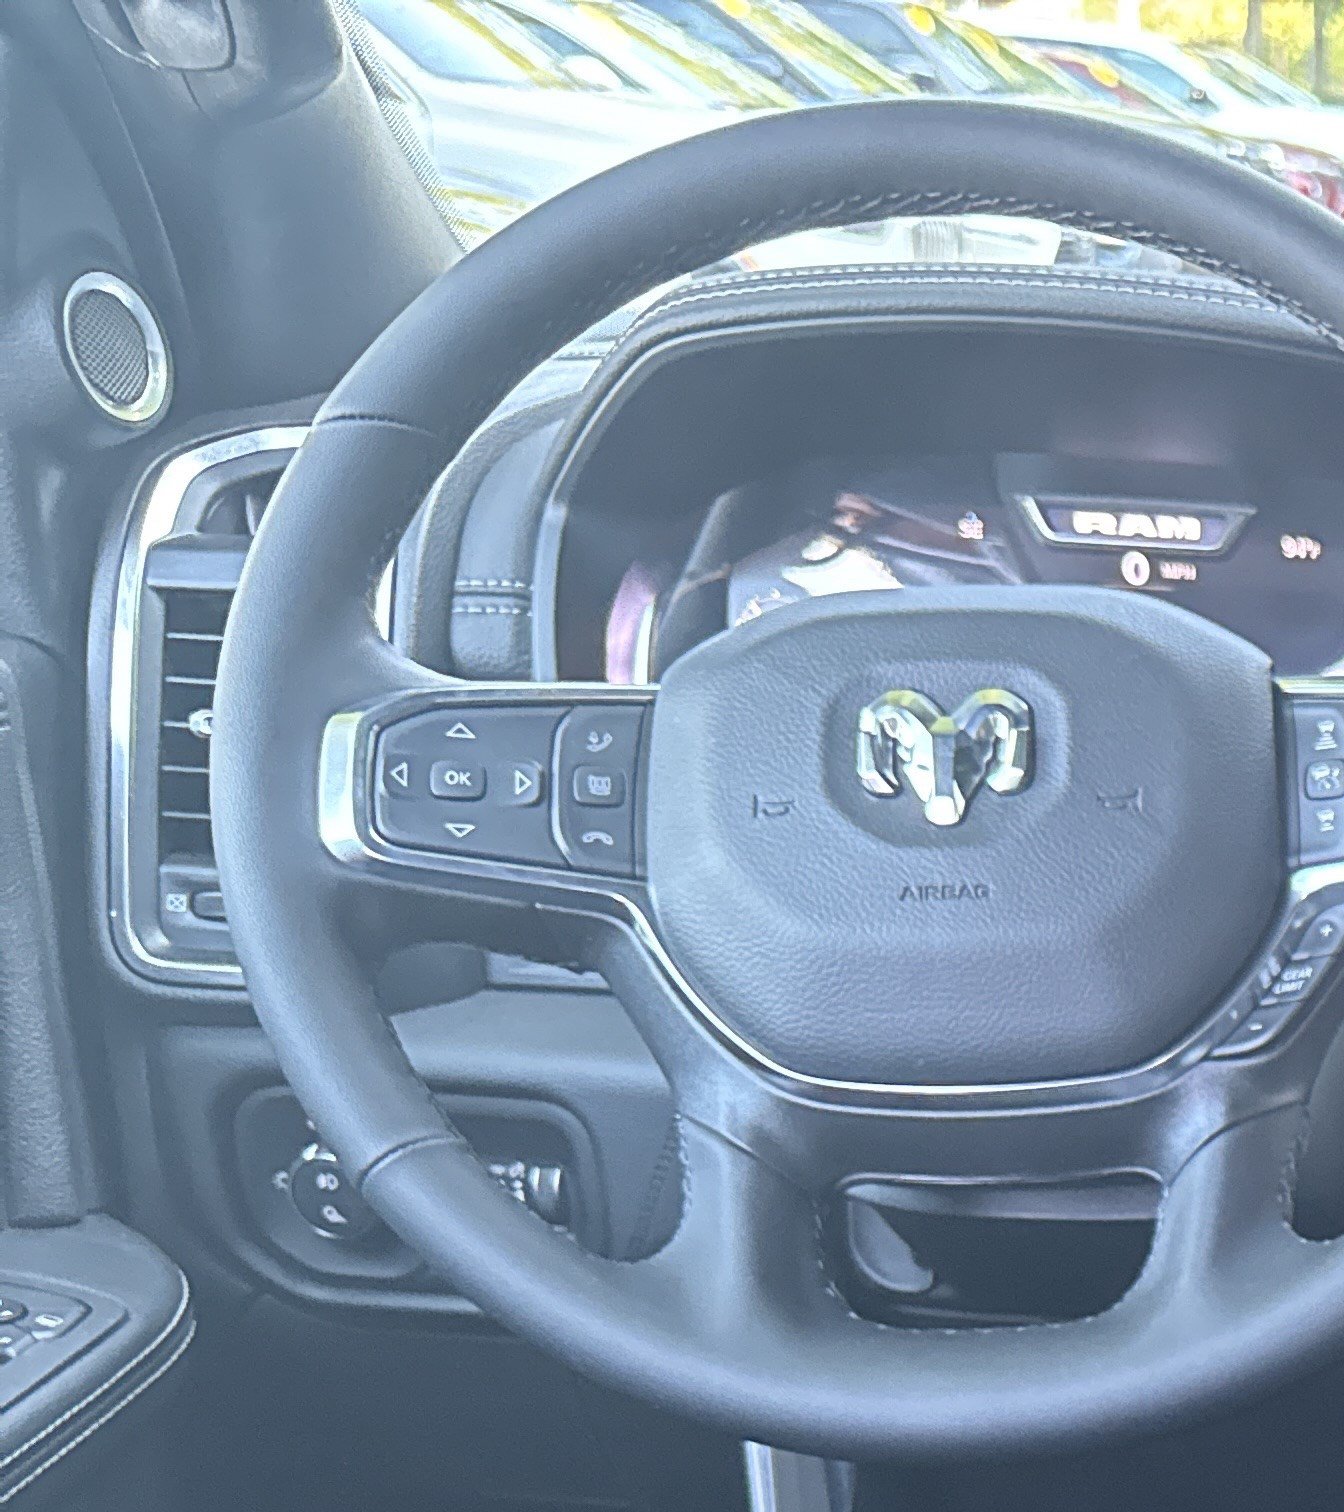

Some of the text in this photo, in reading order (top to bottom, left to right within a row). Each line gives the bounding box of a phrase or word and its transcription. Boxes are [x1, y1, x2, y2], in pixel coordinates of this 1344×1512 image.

[1072, 511, 1202, 541] RAM
[1121, 552, 1197, 586] 0 MPH
[444, 771, 472, 787] OK
[898, 884, 990, 901] AIRBAG
[1280, 966, 1314, 982] GEAR
